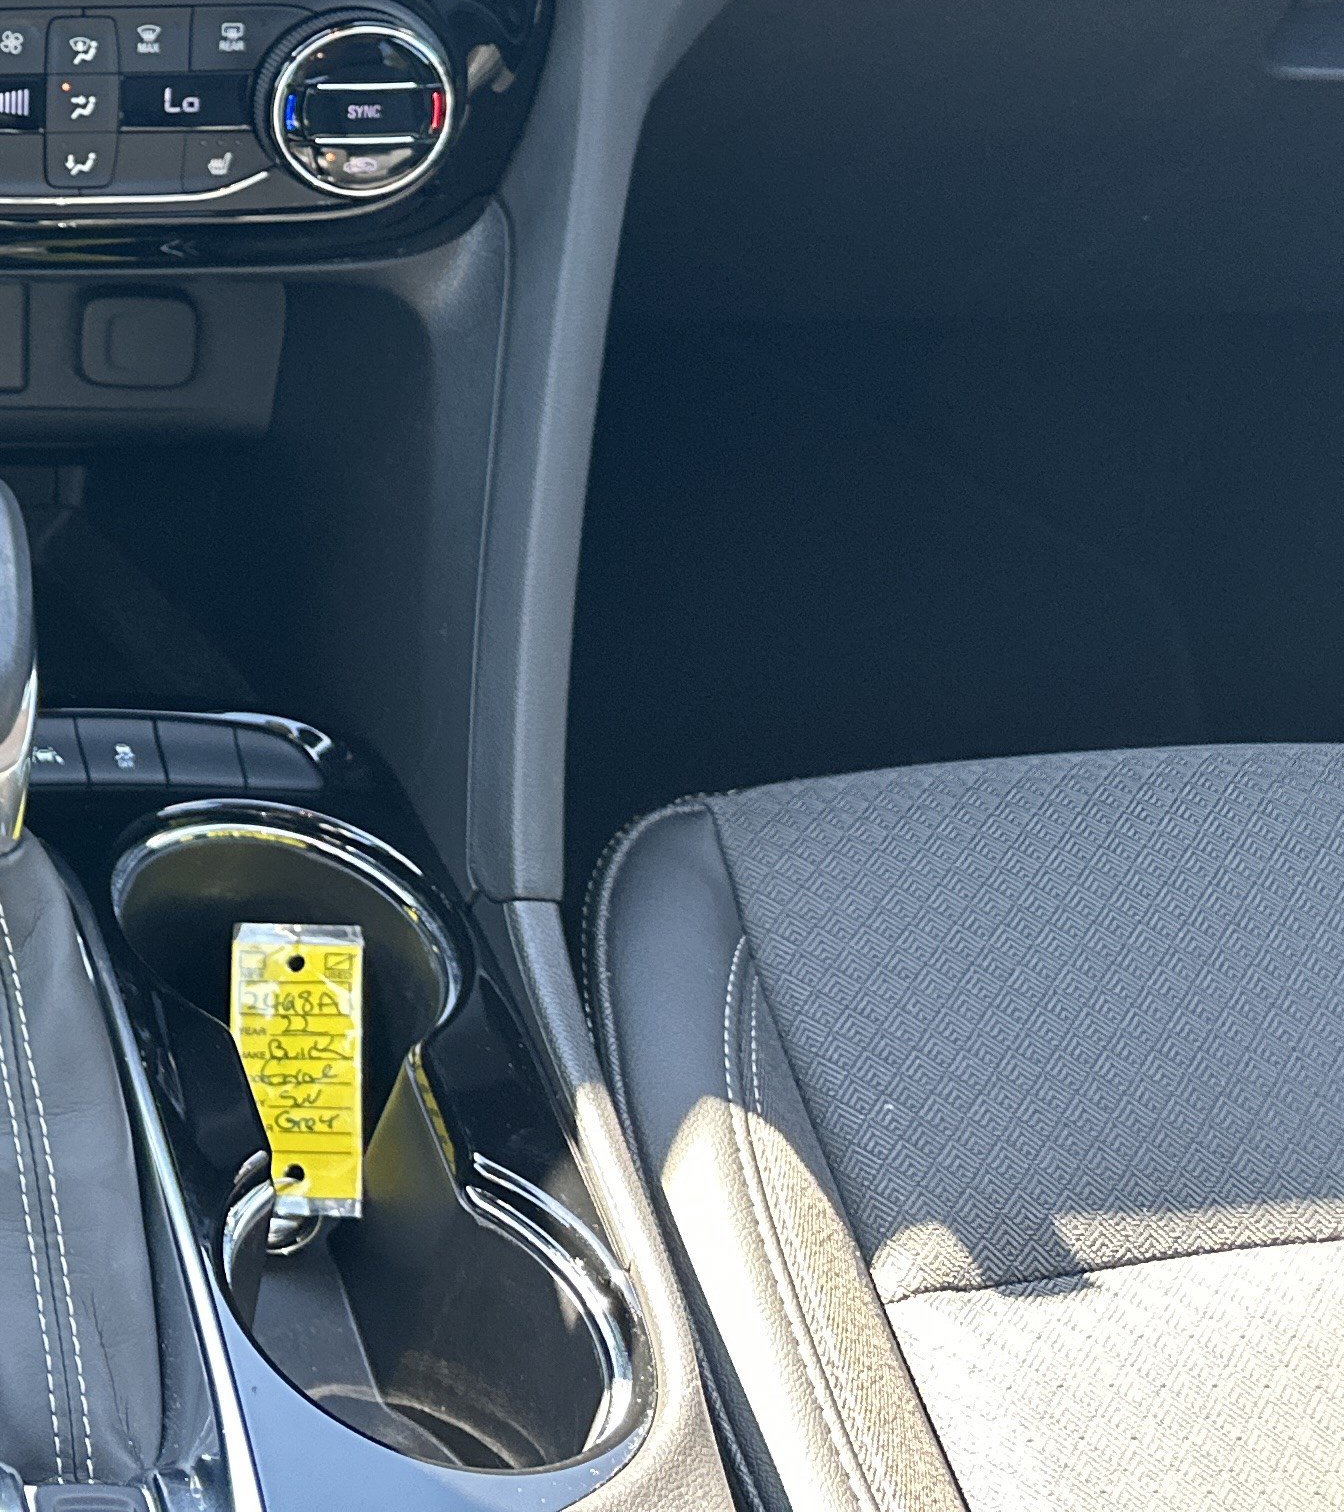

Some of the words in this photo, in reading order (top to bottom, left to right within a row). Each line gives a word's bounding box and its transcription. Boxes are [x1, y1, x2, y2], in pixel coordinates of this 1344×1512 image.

[137, 42, 160, 53] MAX
[164, 87, 200, 114] Lo
[347, 104, 381, 119] SYNC
